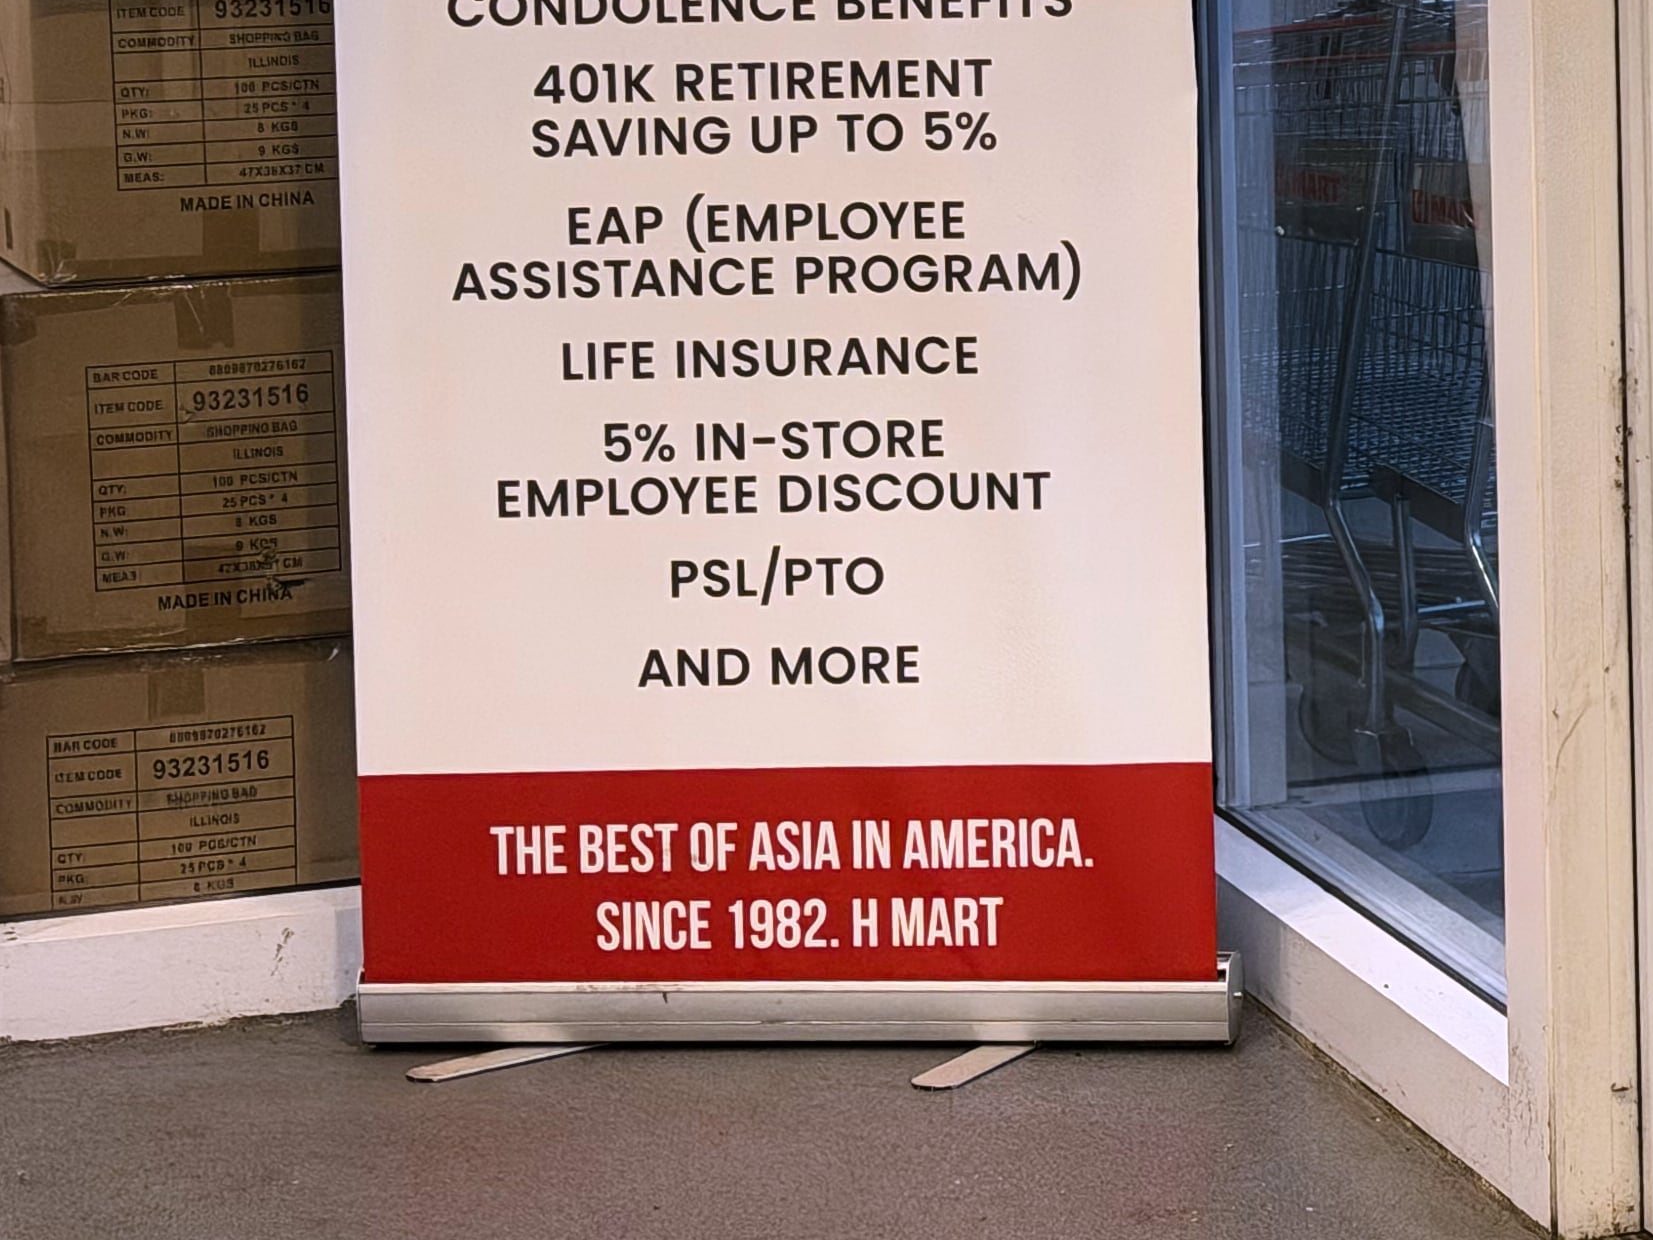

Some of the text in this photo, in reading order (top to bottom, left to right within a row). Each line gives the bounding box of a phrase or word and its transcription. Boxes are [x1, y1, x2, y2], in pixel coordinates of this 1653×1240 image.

[117, 6, 185, 19] ITEM CODE
[118, 35, 195, 49] COMMODITY
[230, 31, 319, 44] SHOPPING BAG
[249, 55, 300, 68] ILLINOIS
[533, 58, 993, 104] 401K RETIREMENT
[262, 101, 289, 113] PCS
[532, 110, 997, 158] SAVING UP TO 5%
[180, 191, 314, 212] MADE IN CHINA
[568, 193, 965, 254] EAP (EMPLOYEE
[452, 240, 1081, 301] ASSISTANCE PROGRAM)
[562, 336, 978, 381] LIFE INSURANCE
[93, 369, 158, 383] BAR CODE
[193, 383, 309, 410] 93231516
[95, 400, 163, 414] ITEM CODE
[96, 430, 173, 446] COMMODITY
[207, 420, 298, 438] SHOPPING BAG
[604, 419, 944, 463] 5% IN-STORE
[233, 446, 283, 460] ILLINOIS
[223, 497, 238, 508] 25
[240, 495, 266, 507] PCS
[497, 471, 1051, 518] EMPLOYEE DISCOUNT
[250, 514, 277, 526] KGS
[670, 545, 884, 606] PSL/PTO
[158, 586, 293, 611] MADE IN CHINA
[638, 645, 920, 688] AND MORE
[83, 738, 118, 750] CODE
[153, 750, 270, 779] 93231516
[55, 769, 123, 783] ITEM CODE
[56, 800, 132, 815] COMMODITY
[190, 813, 240, 827] ILLINOIS
[489, 817, 1094, 875] THE BEST OF ASIA IN AMERICA.
[596, 896, 1004, 951] SINCE 1982. H MART
